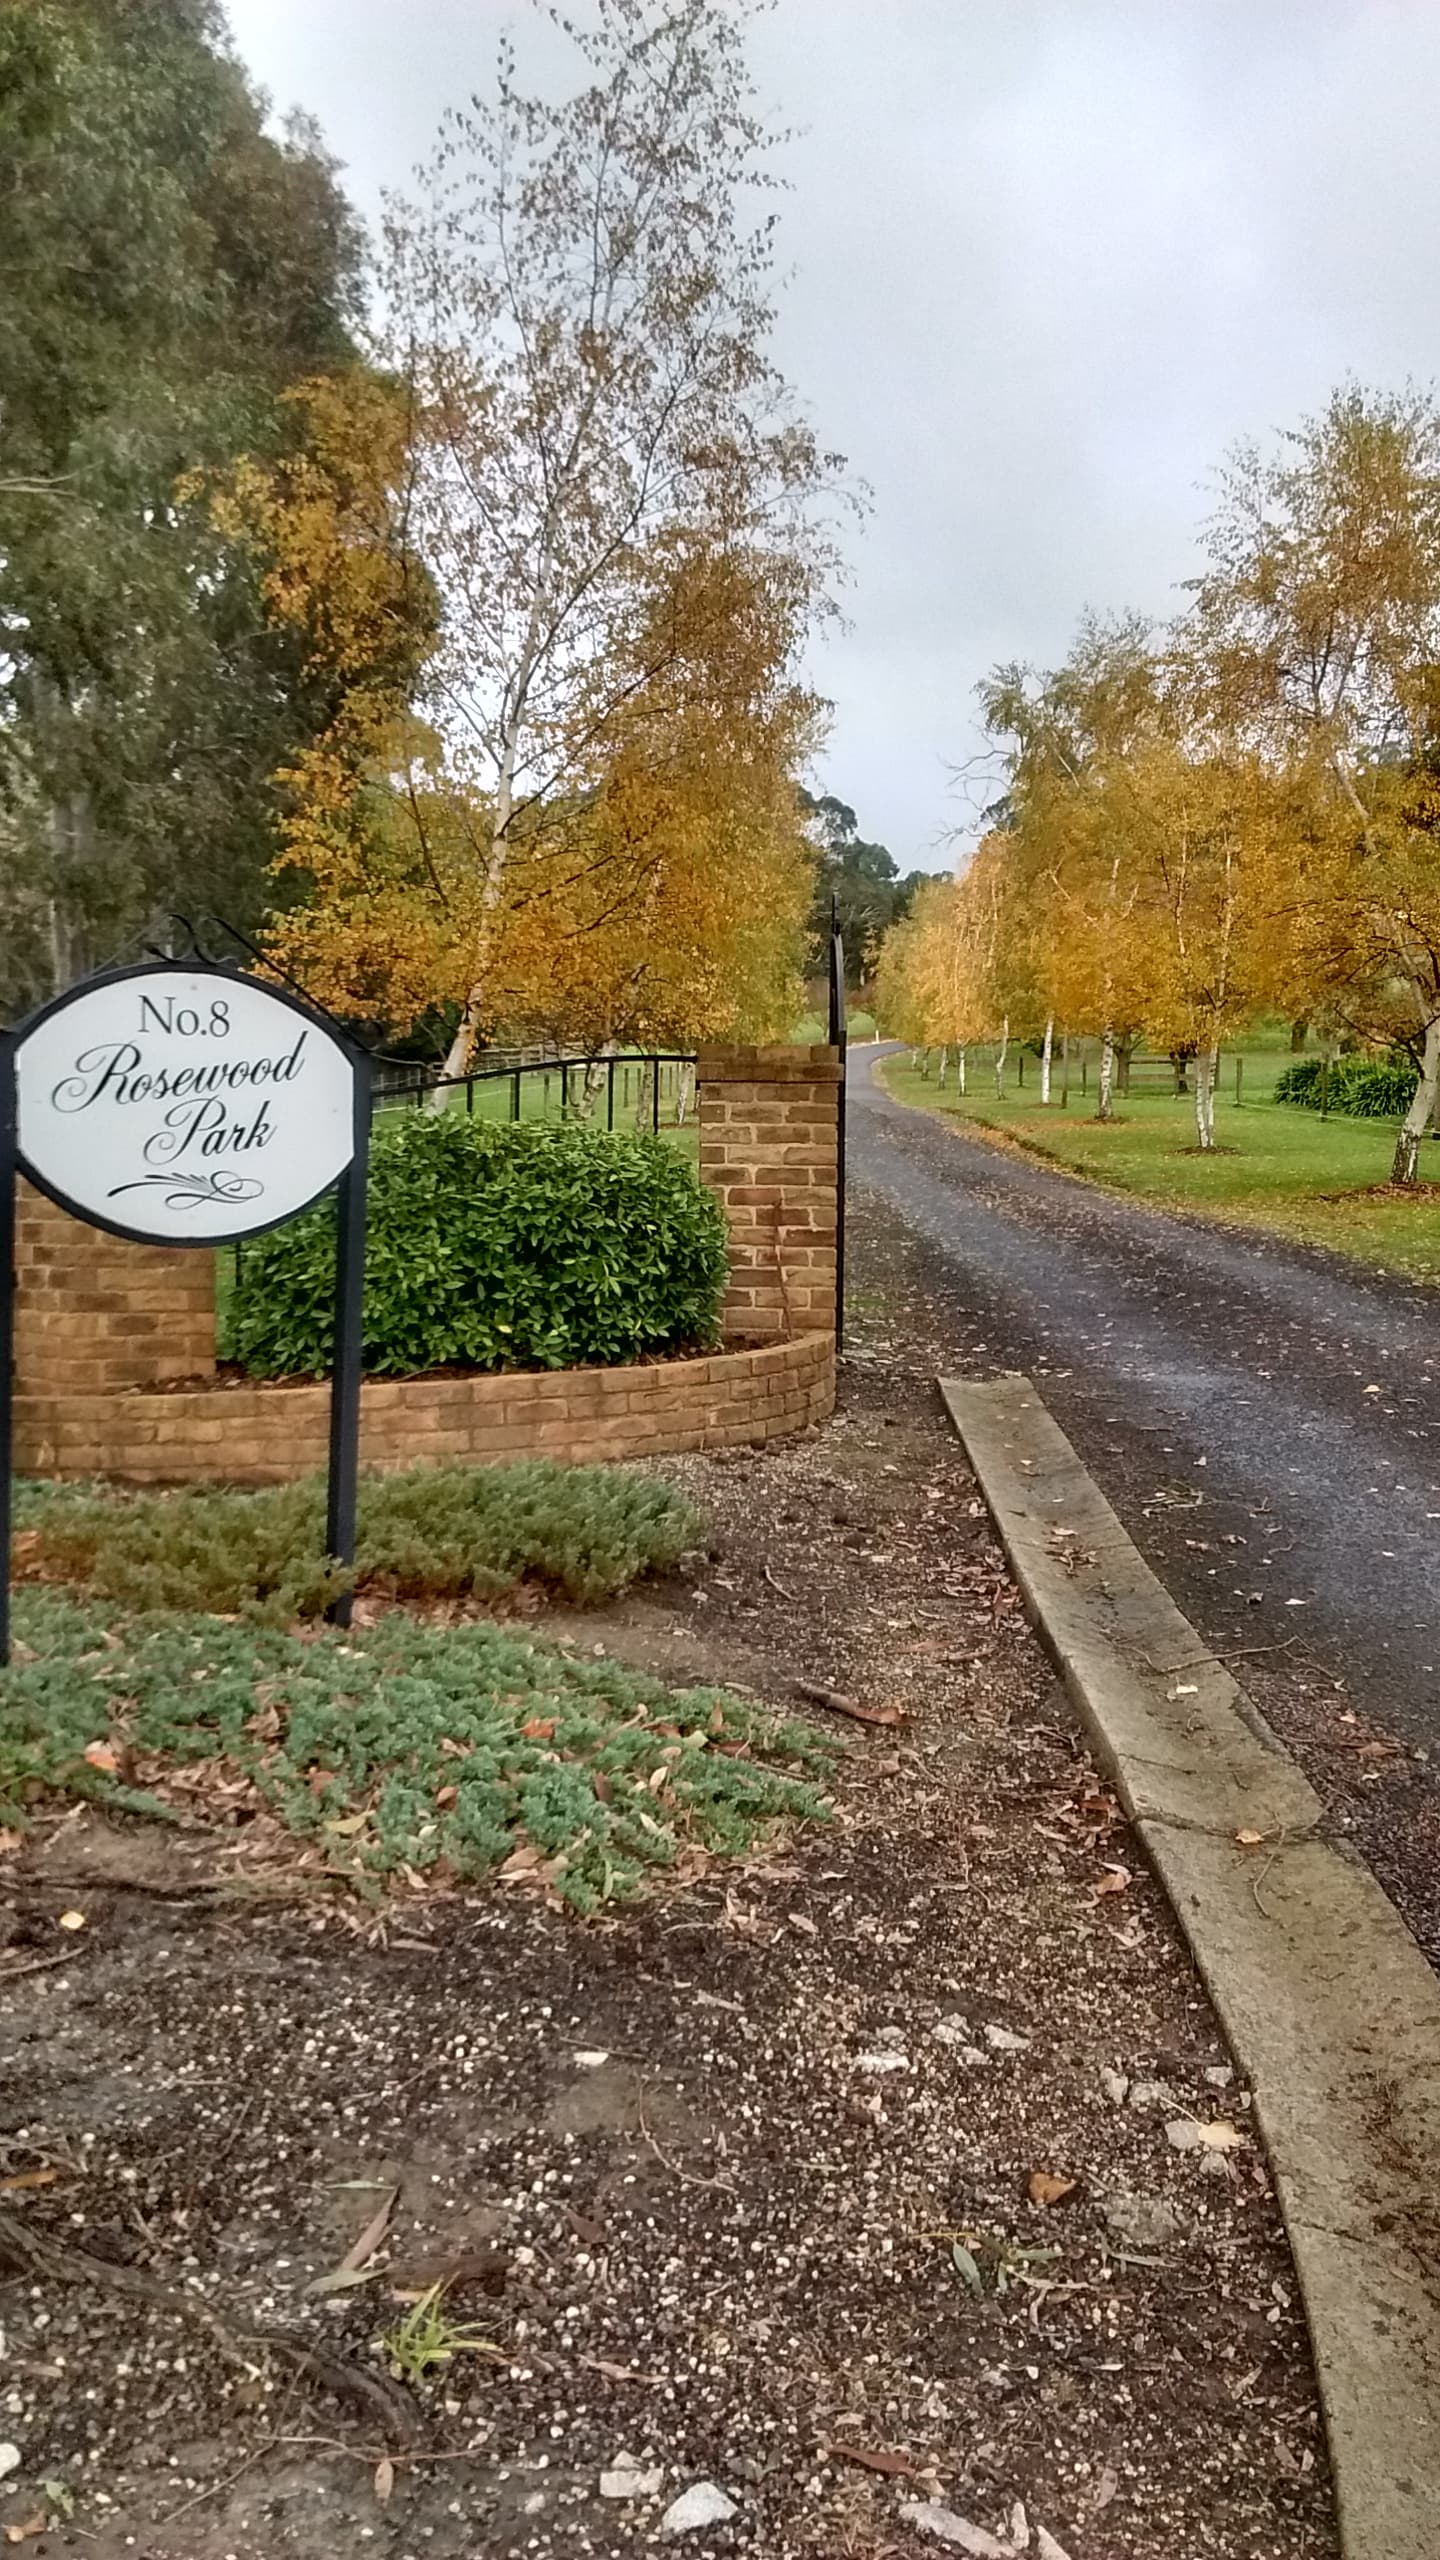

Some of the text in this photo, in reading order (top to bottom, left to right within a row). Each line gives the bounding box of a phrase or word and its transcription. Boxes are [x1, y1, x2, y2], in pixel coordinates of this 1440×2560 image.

[138, 994, 230, 1037] No.8
[51, 1030, 309, 1113] Rosewood
[143, 1095, 278, 1165] Park
